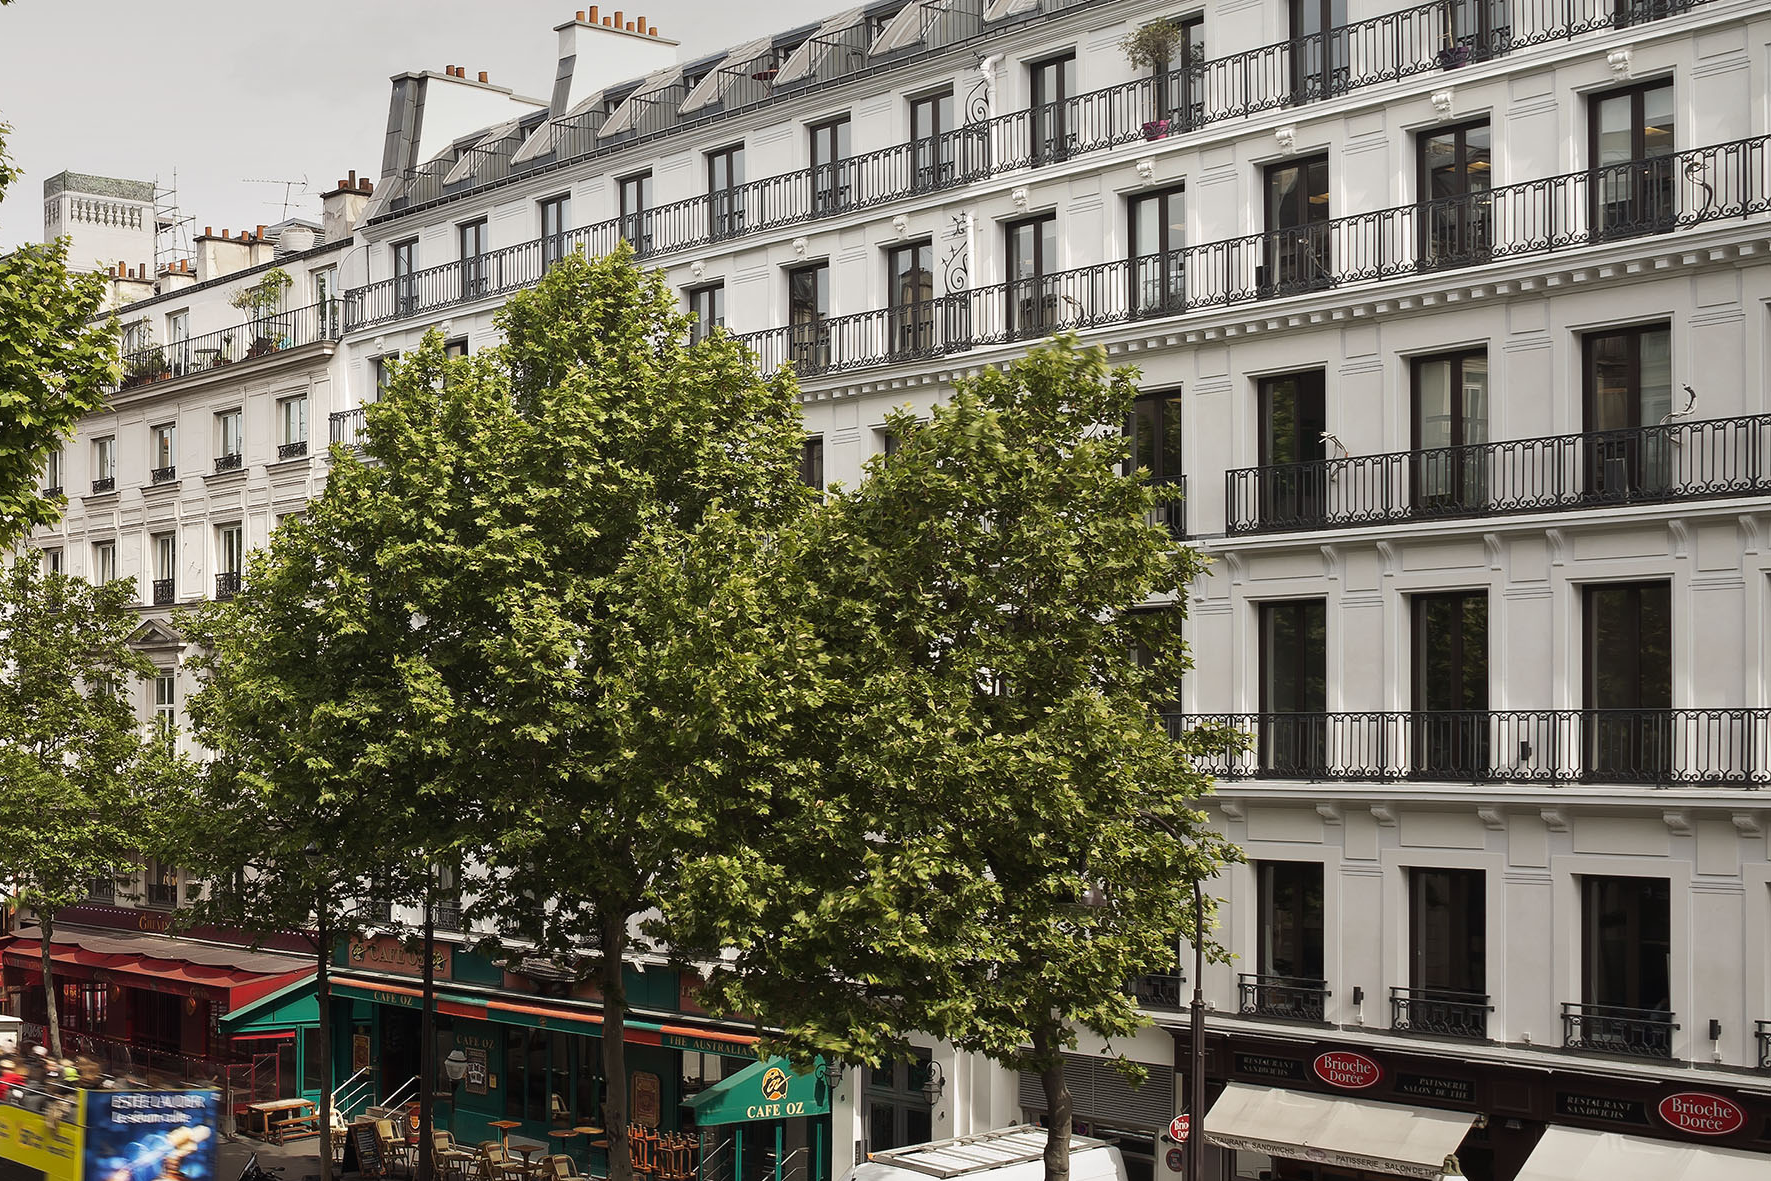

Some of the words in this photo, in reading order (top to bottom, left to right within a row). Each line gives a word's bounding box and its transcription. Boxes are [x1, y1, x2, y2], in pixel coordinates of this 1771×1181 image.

[669, 1036, 687, 1047] THE
[1323, 1055, 1371, 1075] Brioche
[1329, 1070, 1364, 1085] Dorée
[747, 1103, 781, 1119] CAFE
[786, 1102, 805, 1115] OZ
[1566, 1095, 1633, 1112] RESTAURANT
[1672, 1097, 1733, 1119] Brioche
[1174, 1119, 1189, 1131] Brio
[1679, 1113, 1724, 1131] Dorée
[1251, 1142, 1295, 1154] SANDWICHS
[1335, 1155, 1379, 1168] PATISSERIE
